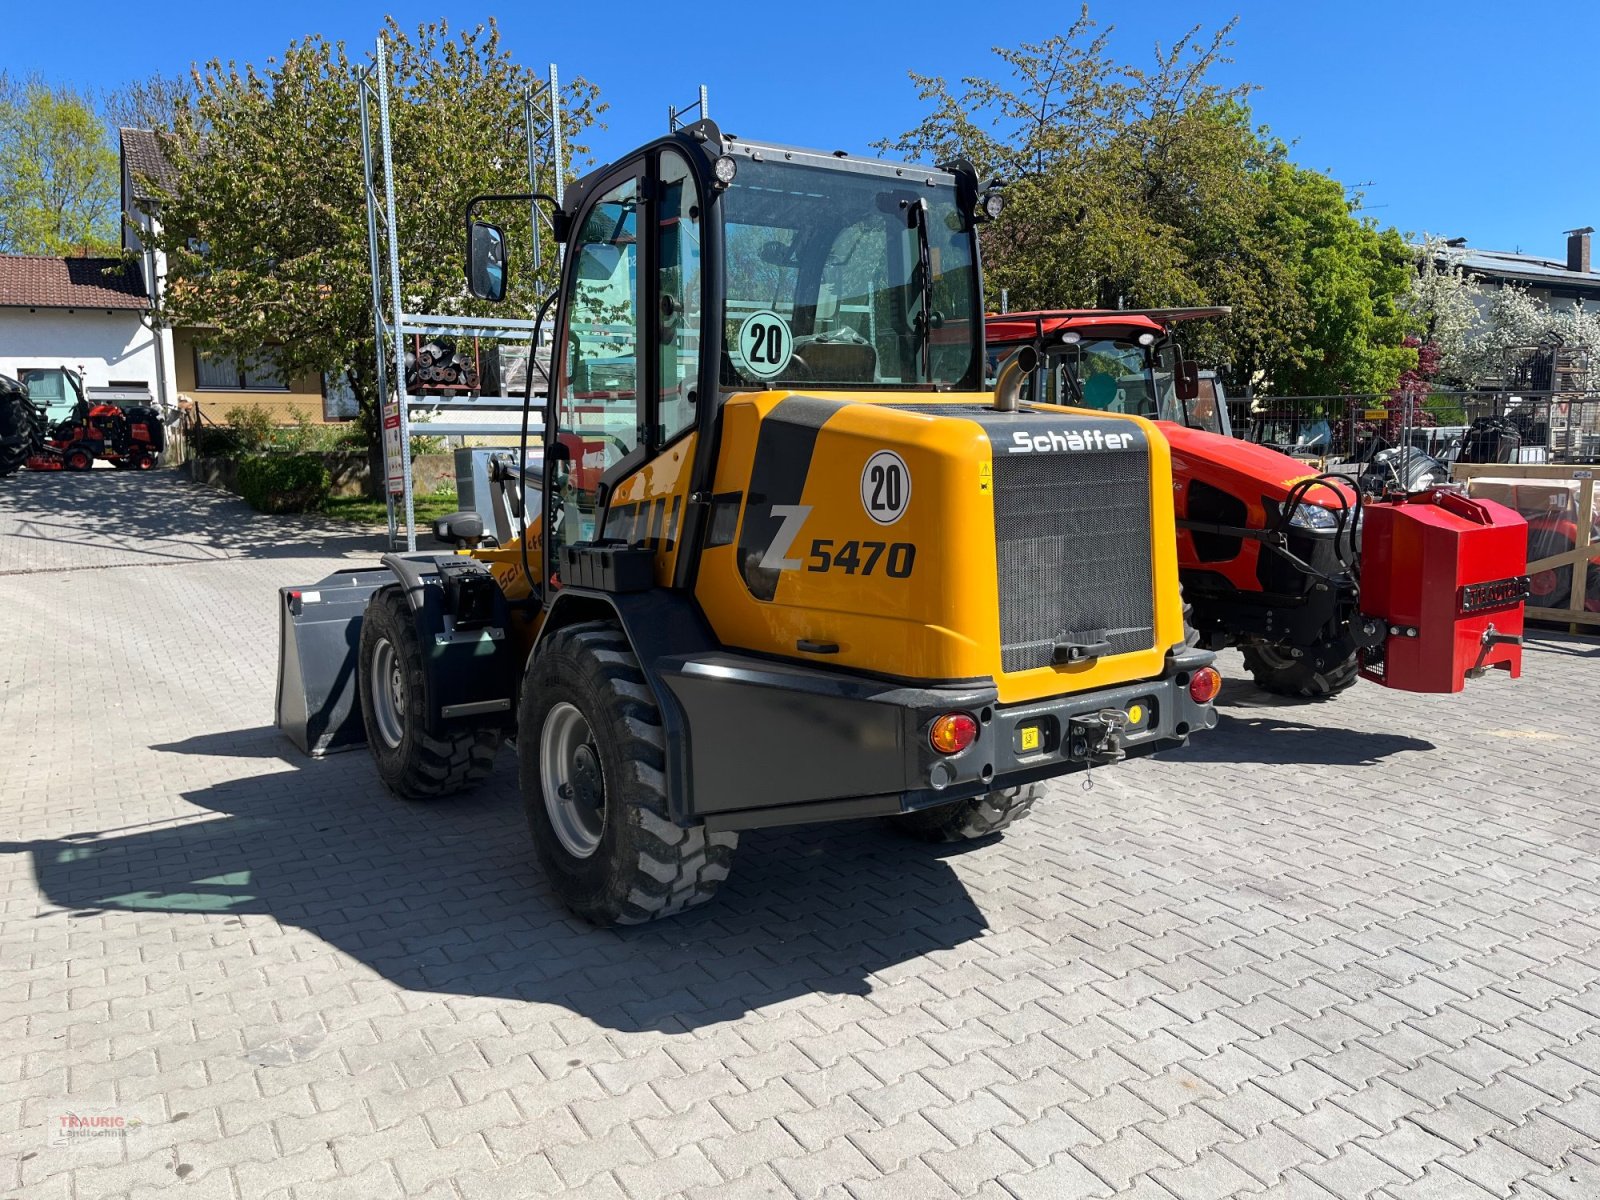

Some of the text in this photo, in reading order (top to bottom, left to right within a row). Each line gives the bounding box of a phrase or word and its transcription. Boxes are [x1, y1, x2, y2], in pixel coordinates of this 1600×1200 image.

[750, 323, 782, 364] 20
[1008, 430, 1134, 453] Schäffer
[870, 464, 901, 511] 20
[758, 504, 917, 579] Z 5470
